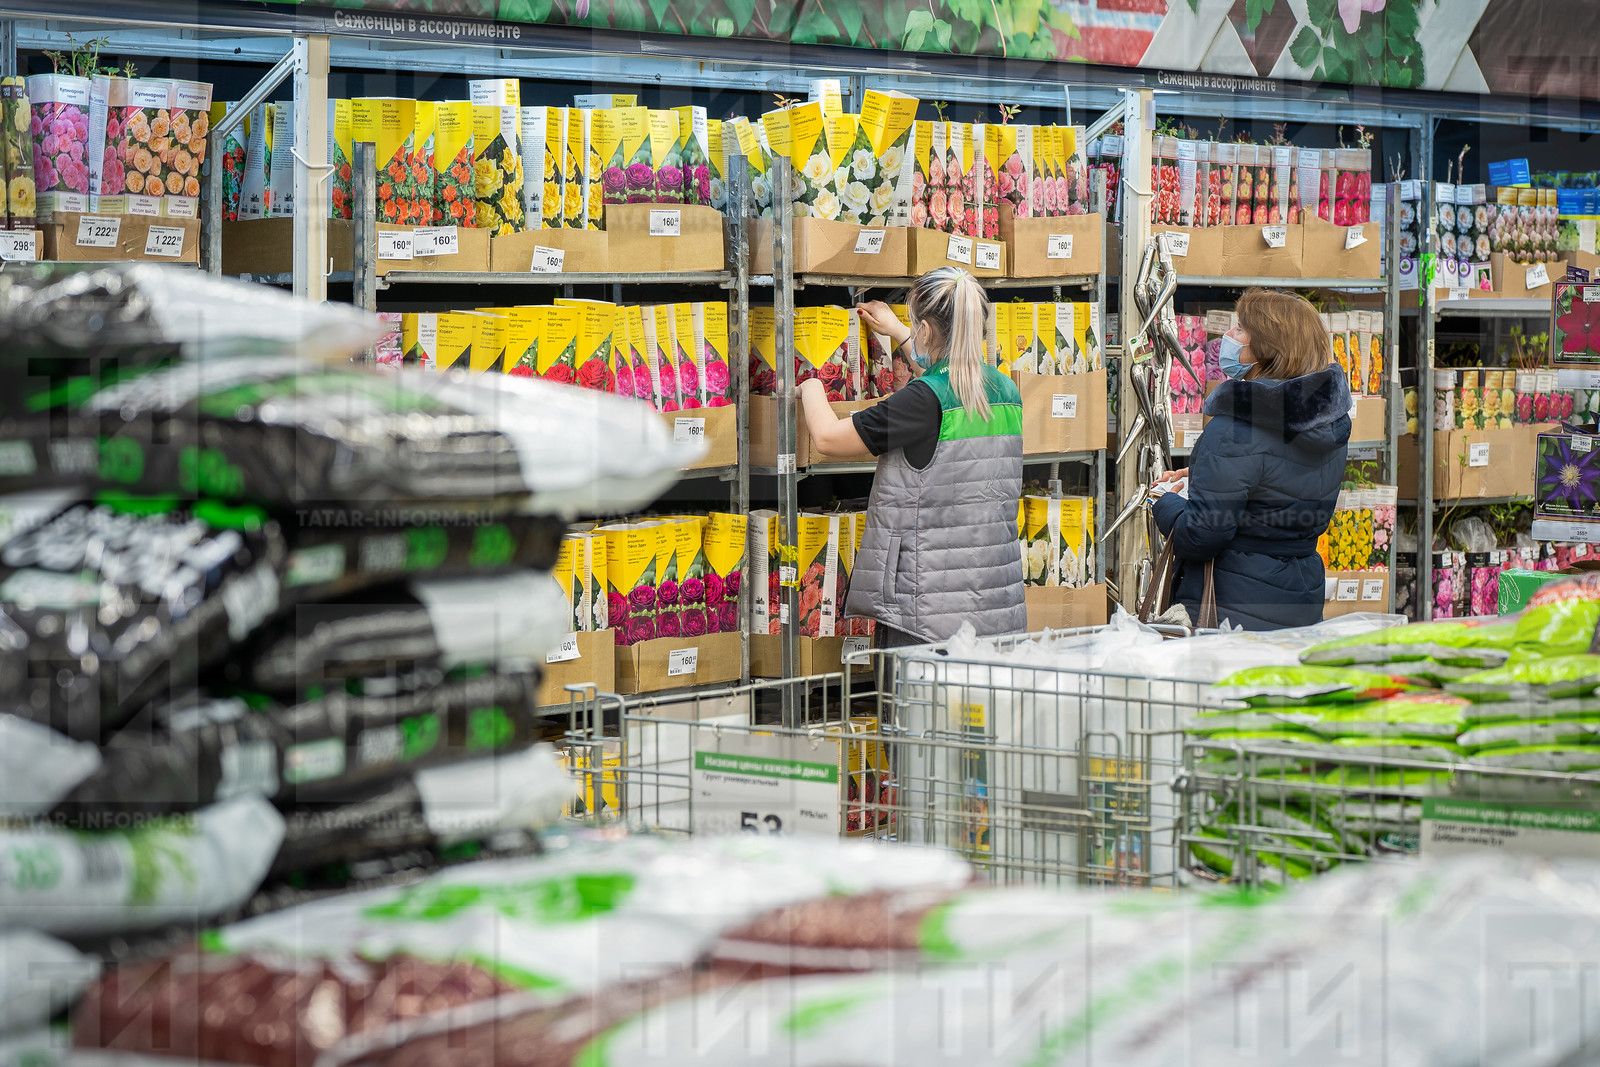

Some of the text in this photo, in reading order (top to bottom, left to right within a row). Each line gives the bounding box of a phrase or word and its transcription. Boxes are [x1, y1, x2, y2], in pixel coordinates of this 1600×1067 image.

[334, 10, 521, 39] Саженцы в ассортименте
[1158, 70, 1276, 92] Саженцы в ассортименте
[662, 218, 674, 227] 160
[392, 241, 406, 249] 160
[433, 236, 450, 245] 160
[868, 238, 878, 246] 160
[14, 241, 29, 250] 298
[957, 245, 967, 254] 160
[546, 256, 558, 267] 160
[688, 426, 699, 435] 160
[682, 656, 692, 665] 160
[704, 756, 738, 769] Низкие
[739, 760, 762, 772] цены
